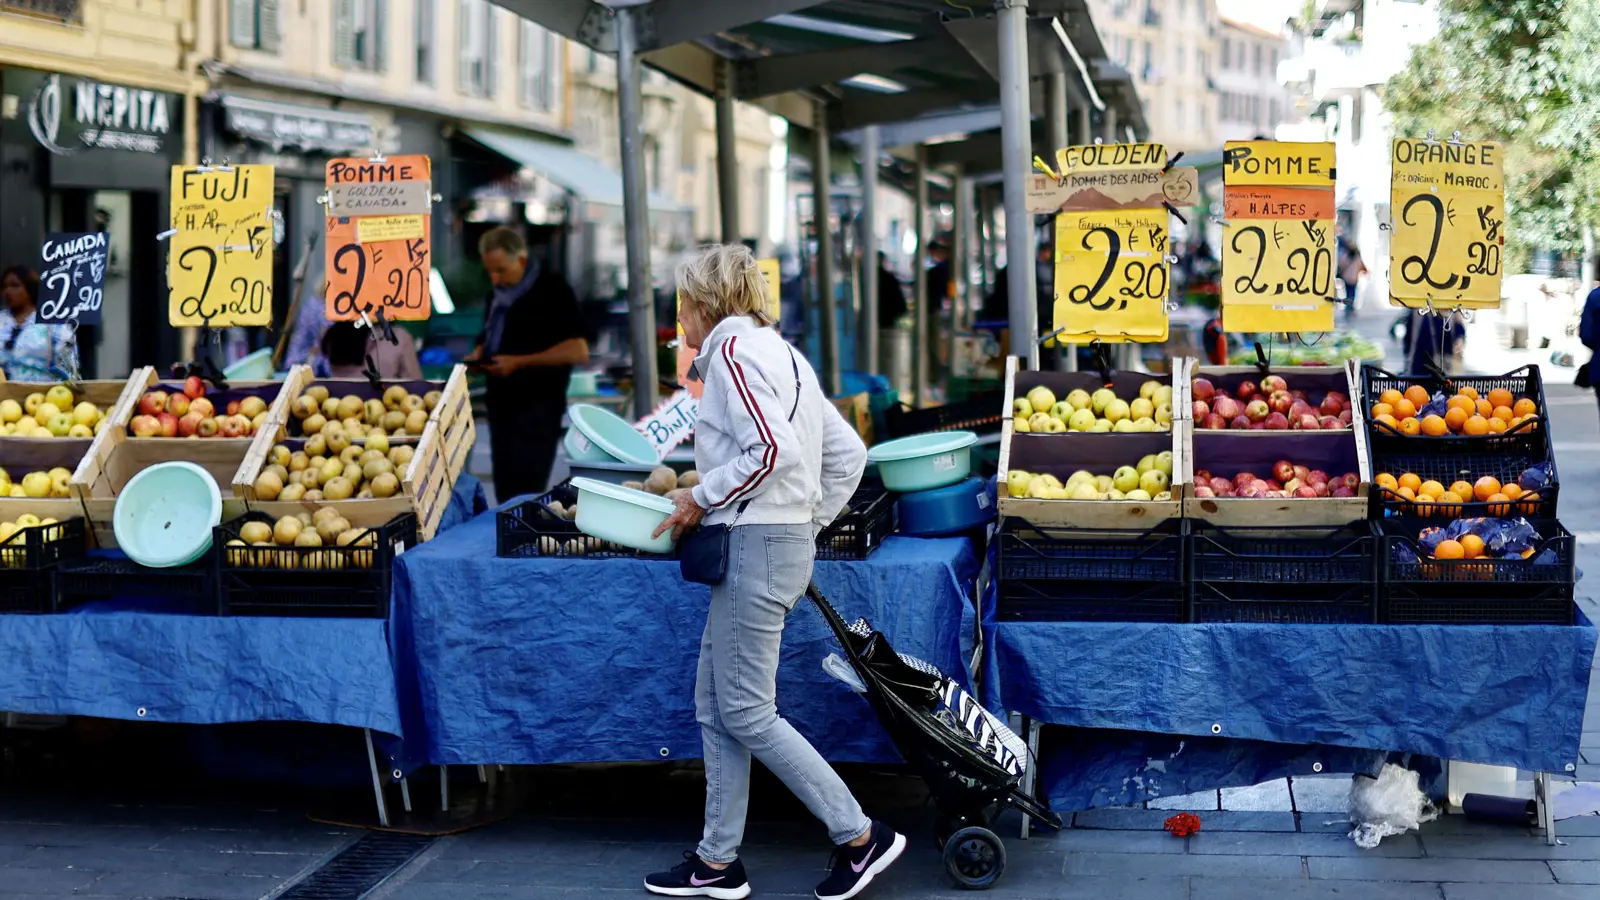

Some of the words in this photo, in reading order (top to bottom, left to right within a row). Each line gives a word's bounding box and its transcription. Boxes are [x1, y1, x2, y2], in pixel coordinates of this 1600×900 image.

[76, 81, 169, 134] NEPITA
[1066, 144, 1163, 168] GOLDEN
[1228, 147, 1321, 174] POMME
[1396, 140, 1495, 165] ORANGE
[330, 162, 413, 182] POMME
[1072, 175, 1107, 188] POMME
[1110, 174, 1128, 186] DES
[1131, 172, 1159, 185] ALPES
[348, 186, 398, 197] GOLDEN
[345, 199, 400, 209] CANADA
[42, 232, 105, 262] CANADA
